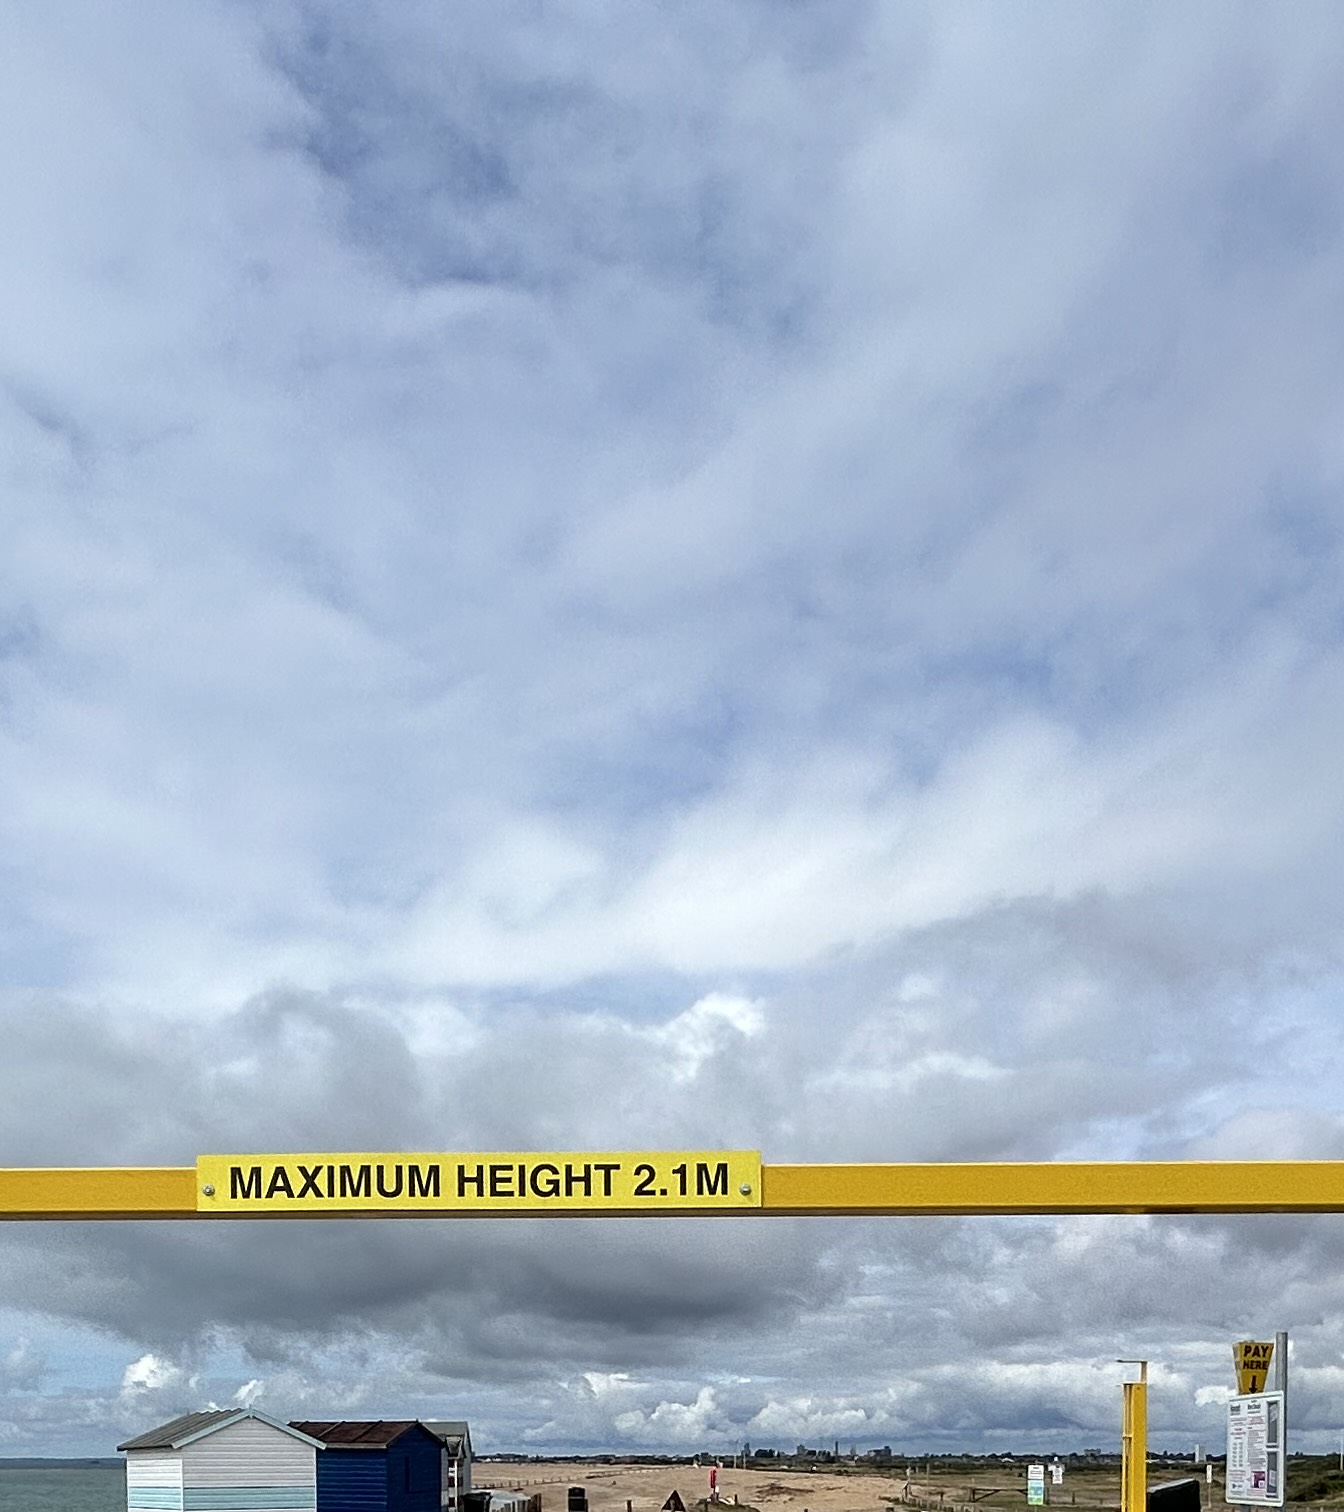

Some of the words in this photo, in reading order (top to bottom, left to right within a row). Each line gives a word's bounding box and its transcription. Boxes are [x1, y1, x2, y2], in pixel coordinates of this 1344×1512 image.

[230, 1164, 440, 1199] MAXIMUM
[457, 1163, 620, 1197] HEIGHT
[633, 1162, 728, 1196] 2.1M
[1244, 1345, 1269, 1357] PAY
[1243, 1360, 1268, 1370] HERE
